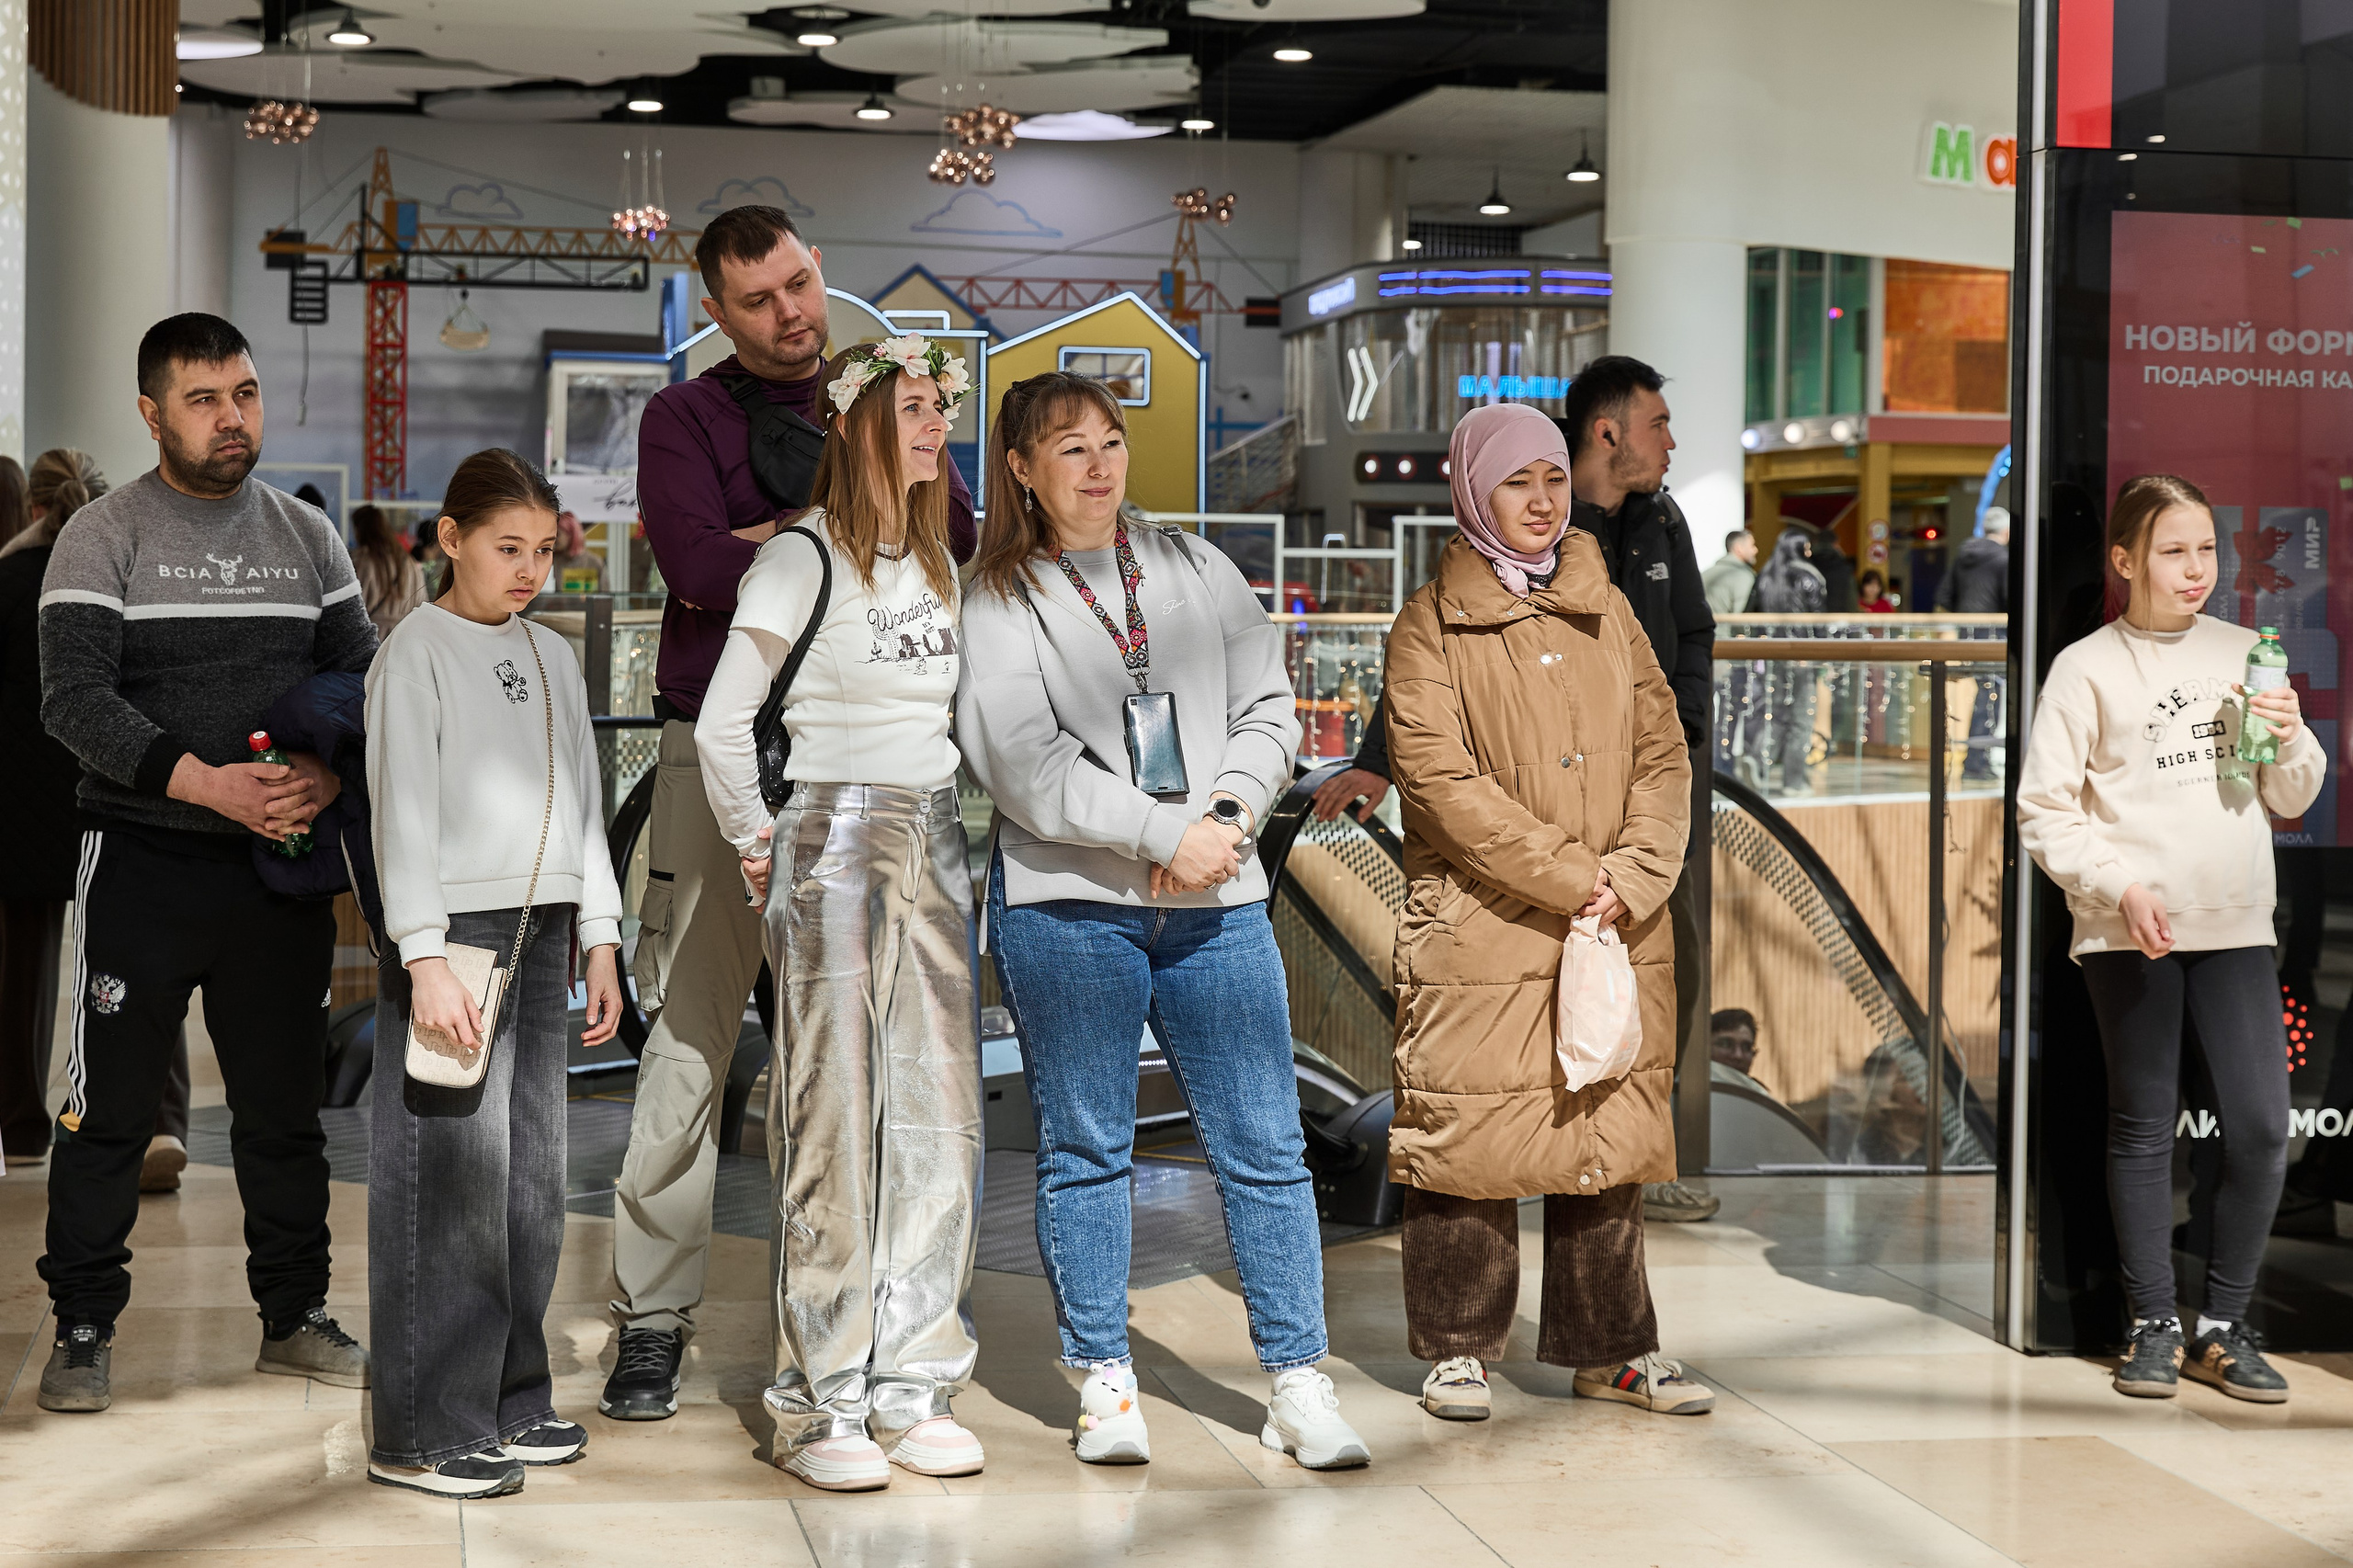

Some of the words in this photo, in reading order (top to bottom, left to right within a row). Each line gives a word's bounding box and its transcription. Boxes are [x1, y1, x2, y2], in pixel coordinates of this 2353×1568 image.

[2125, 321, 2256, 353] НОВЫЙ
[2267, 328, 2353, 357] ФОР
[2143, 365, 2314, 388] ПОДАРОЧНАЯ
[2303, 516, 2321, 570] МИР
[158, 564, 212, 580] BCIA
[245, 566, 299, 580] AIYU
[867, 592, 943, 632] Wonderful
[2143, 677, 2245, 744] SHERM
[2156, 751, 2198, 769] HIGH
